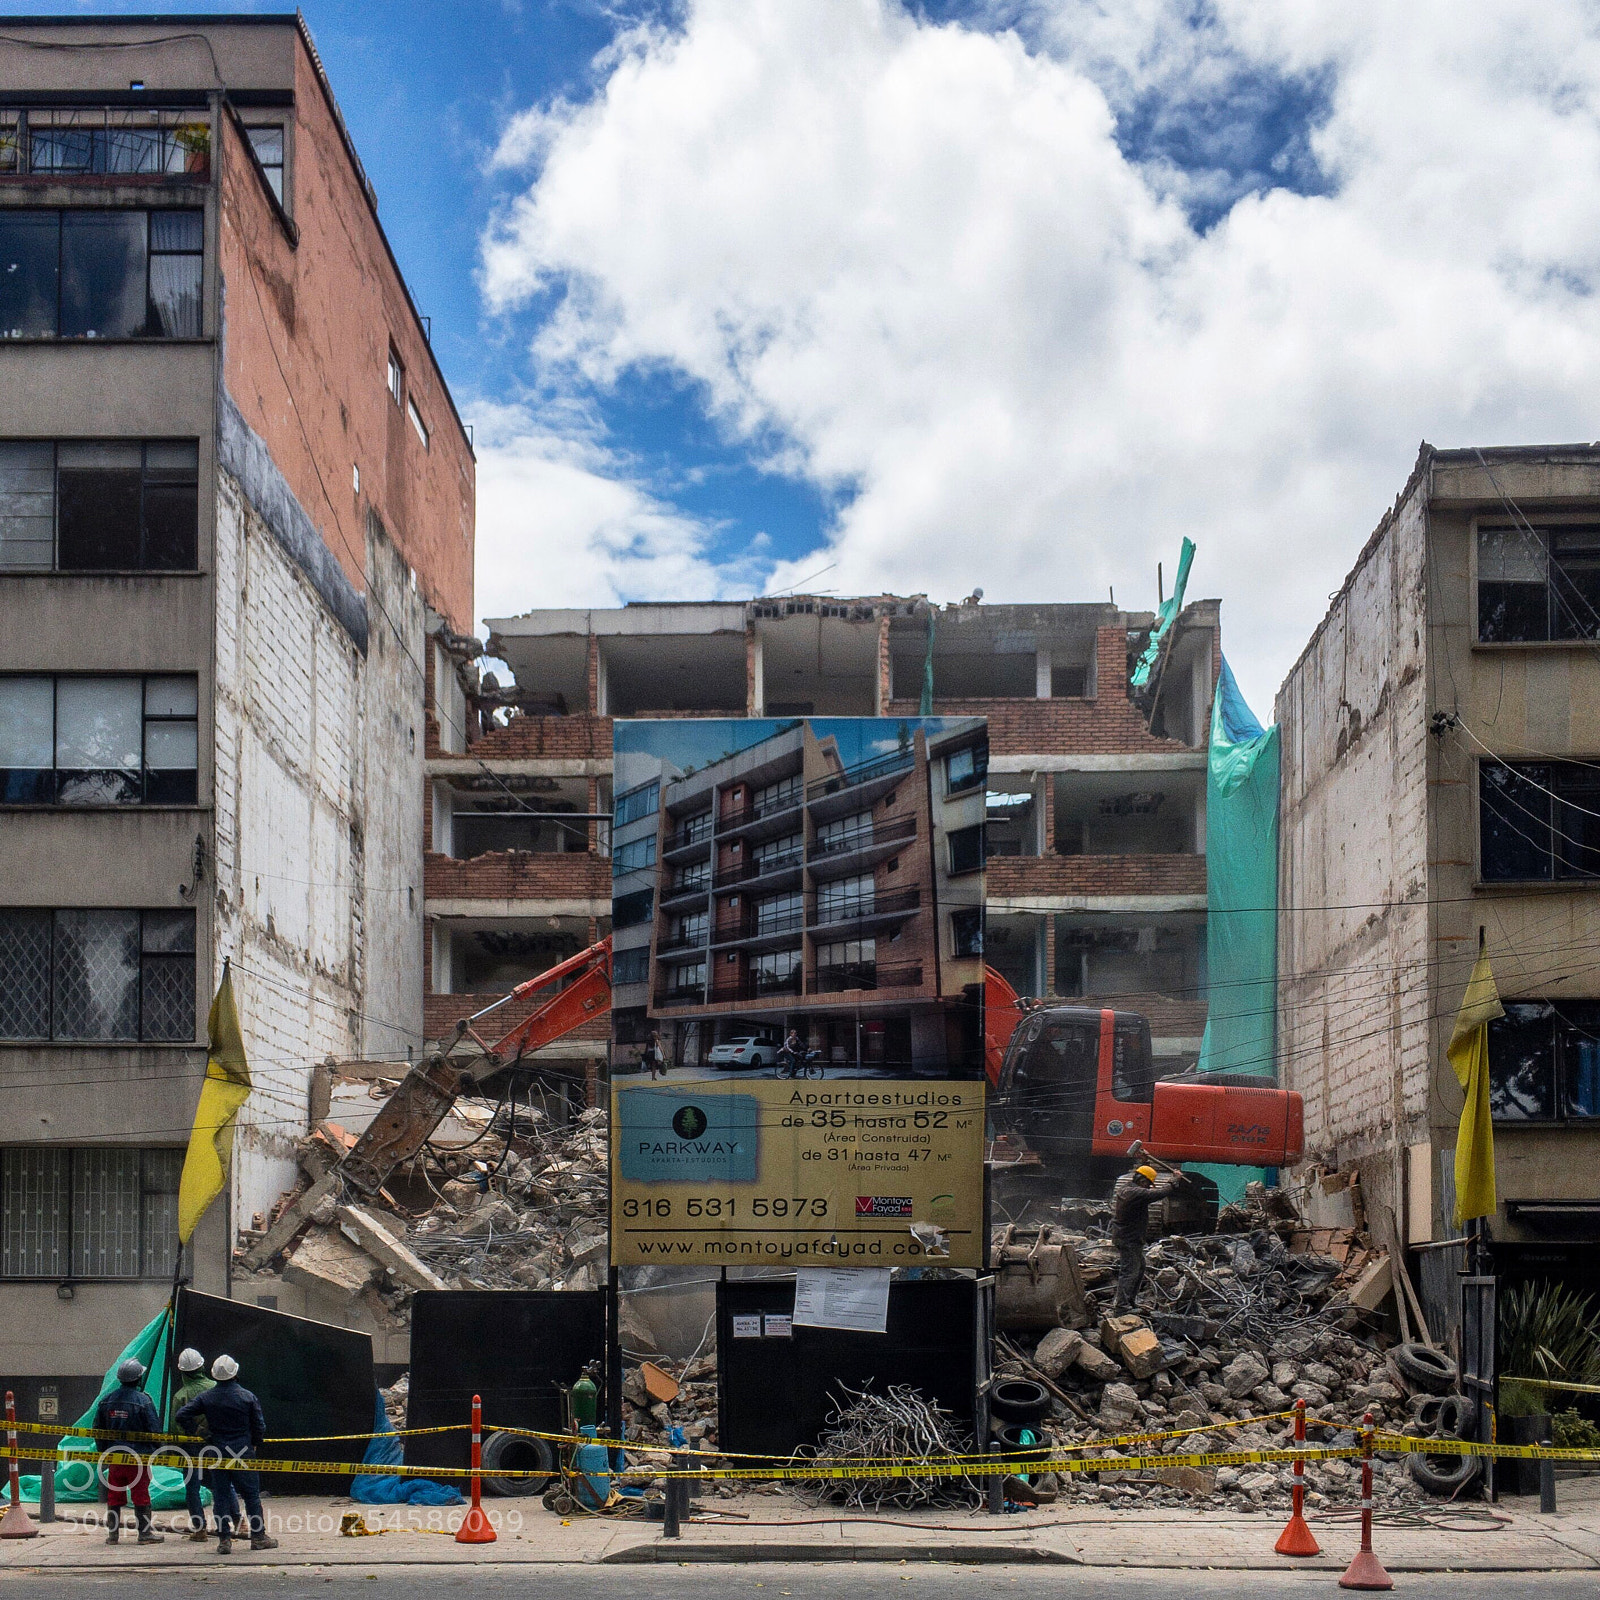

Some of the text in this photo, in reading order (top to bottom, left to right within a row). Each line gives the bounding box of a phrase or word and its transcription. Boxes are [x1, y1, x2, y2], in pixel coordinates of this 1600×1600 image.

[789, 1091, 962, 1107] Apartaestudios
[781, 1115, 805, 1128] de
[811, 1110, 847, 1128] 35
[854, 1115, 907, 1129] hasta
[913, 1111, 949, 1129] 52
[823, 1132, 931, 1144] (Área Construida)
[639, 1142, 739, 1154] PARKWAY
[801, 1150, 822, 1161] de
[827, 1149, 849, 1161] 31
[854, 1150, 900, 1161] hasta
[907, 1149, 932, 1161] 47
[874, 1164, 910, 1172] Privada)
[872, 1197, 912, 1206] Montoya
[623, 1199, 828, 1217] 316 531 5973
[872, 1205, 900, 1213] Fayad
